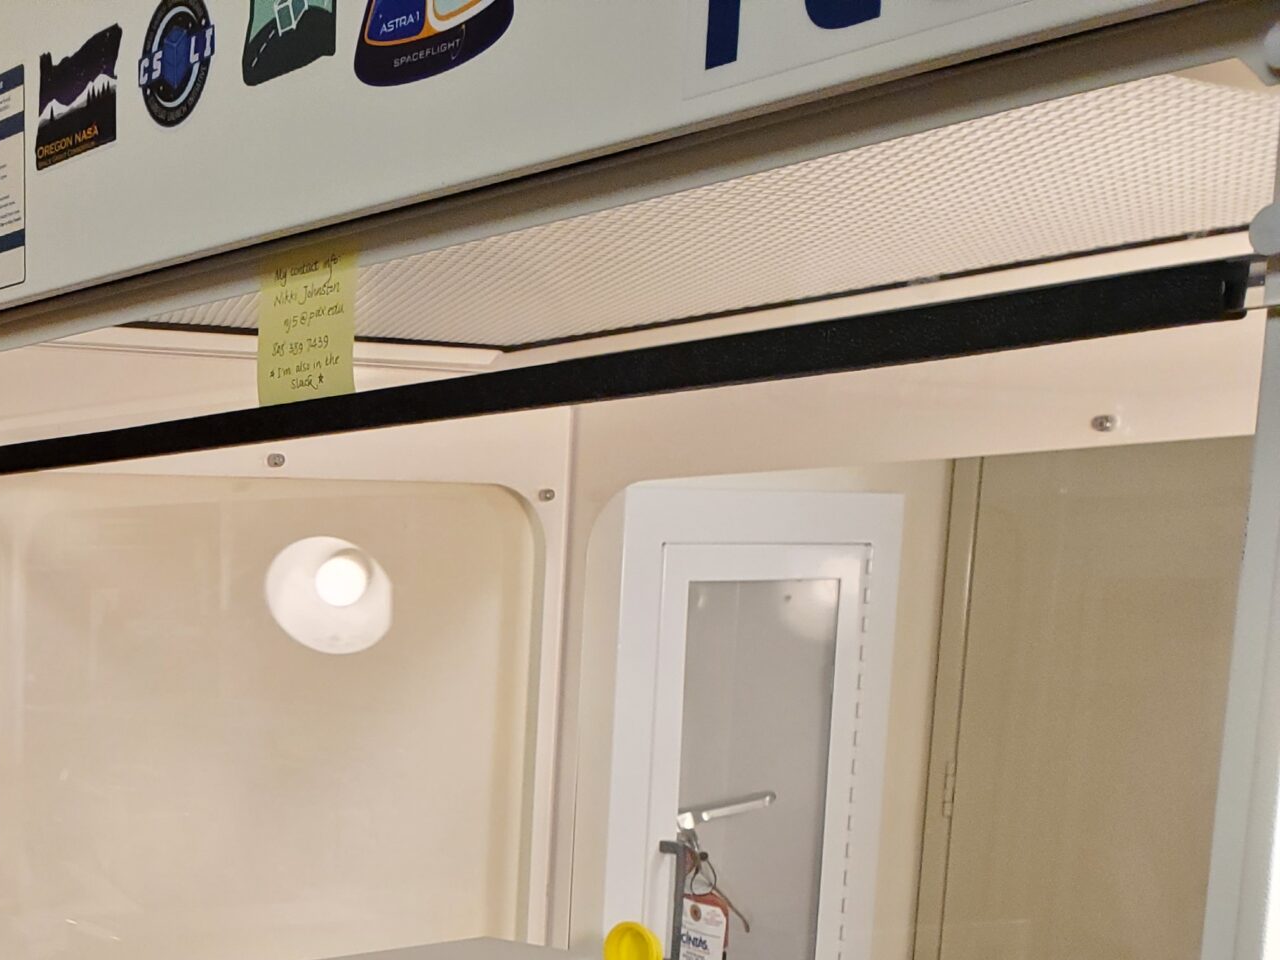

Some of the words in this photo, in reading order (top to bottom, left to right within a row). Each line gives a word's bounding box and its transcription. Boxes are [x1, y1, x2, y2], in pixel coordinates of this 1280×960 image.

[393, 38, 461, 68] SPACEFLIGHT
[37, 135, 73, 159] OREGON
[74, 123, 99, 144] NASA
[274, 268, 287, 287] My
[290, 261, 320, 276] contact
[296, 361, 310, 373] also
[314, 360, 322, 368] in
[325, 353, 340, 366] the
